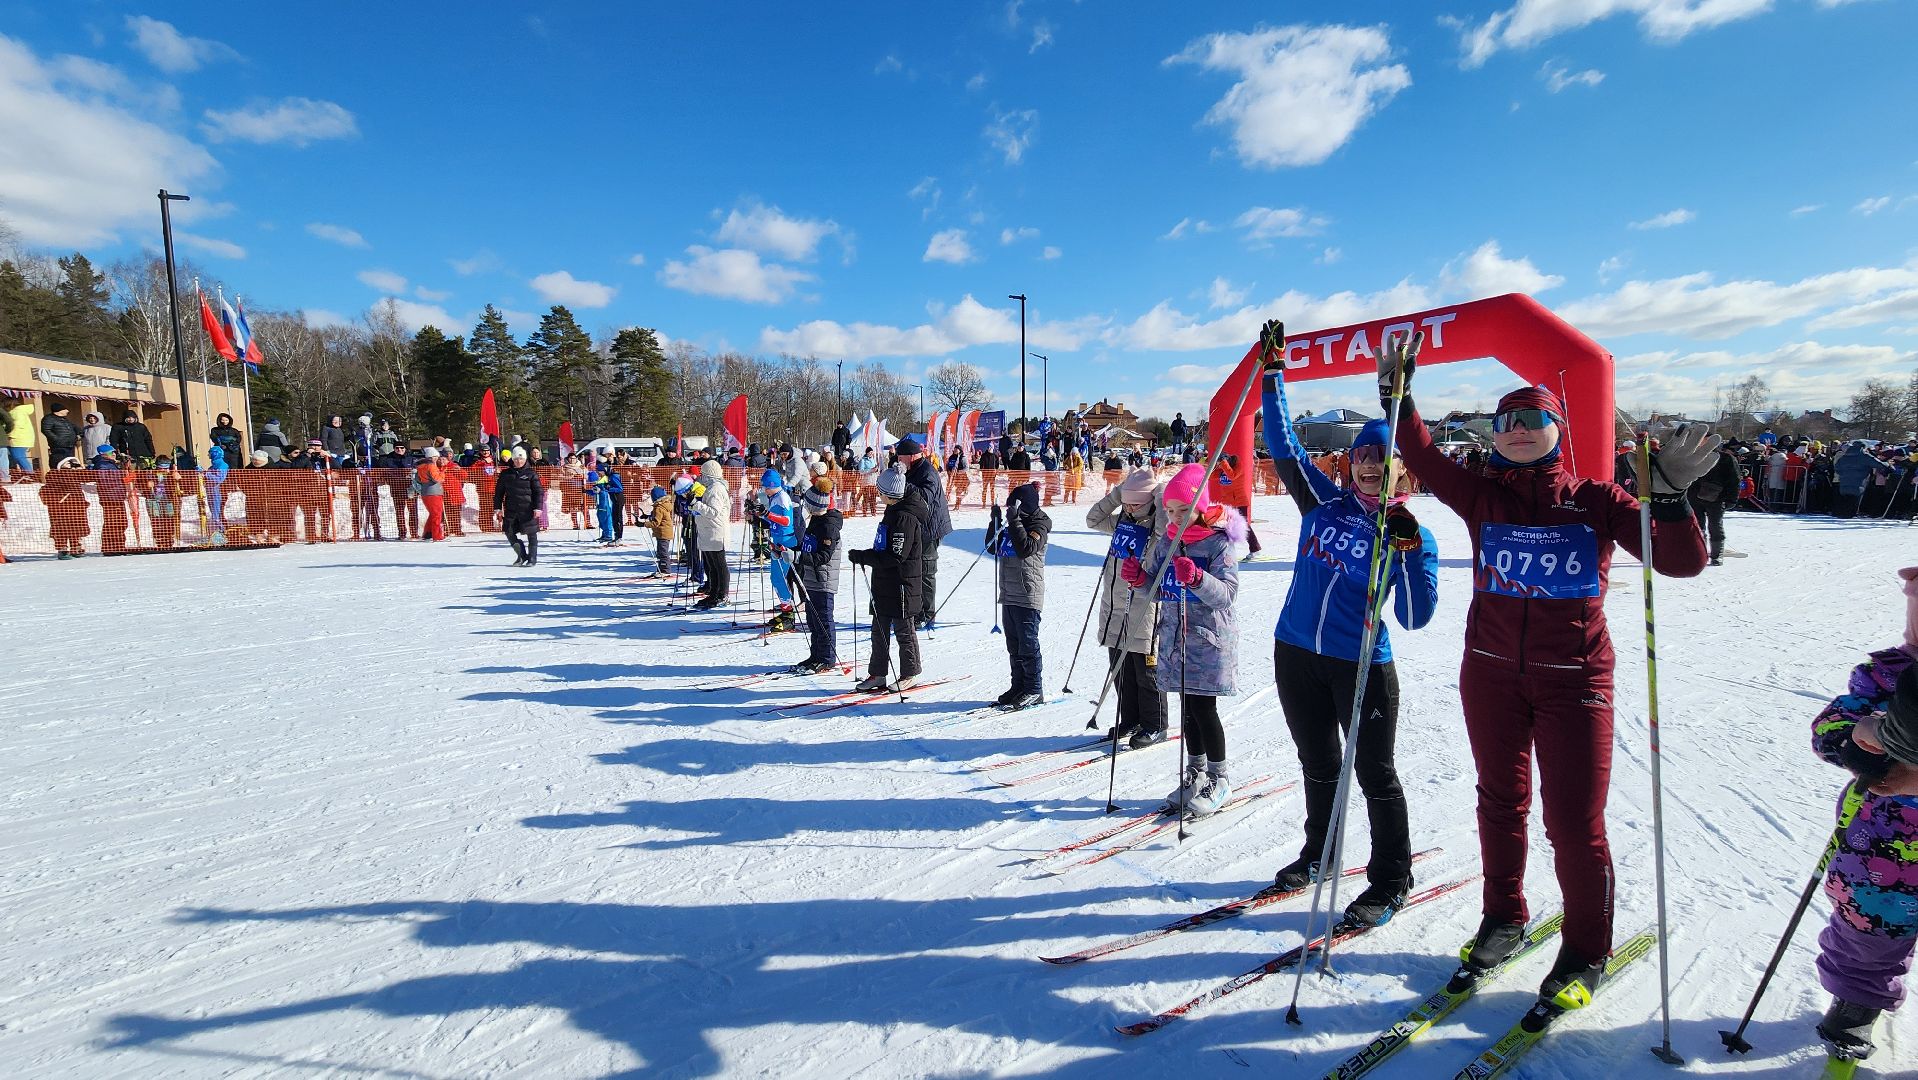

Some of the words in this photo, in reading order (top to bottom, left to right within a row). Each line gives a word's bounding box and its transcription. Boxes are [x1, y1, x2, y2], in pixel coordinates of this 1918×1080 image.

[1285, 312, 1457, 370] СТАРТ
[1502, 536, 1537, 545] ЛЫЖНОГО
[1539, 537, 1570, 545] СПОРТА
[1511, 530, 1561, 540] ФЕСТИВАЛЬ
[1496, 549, 1582, 576] 0796
